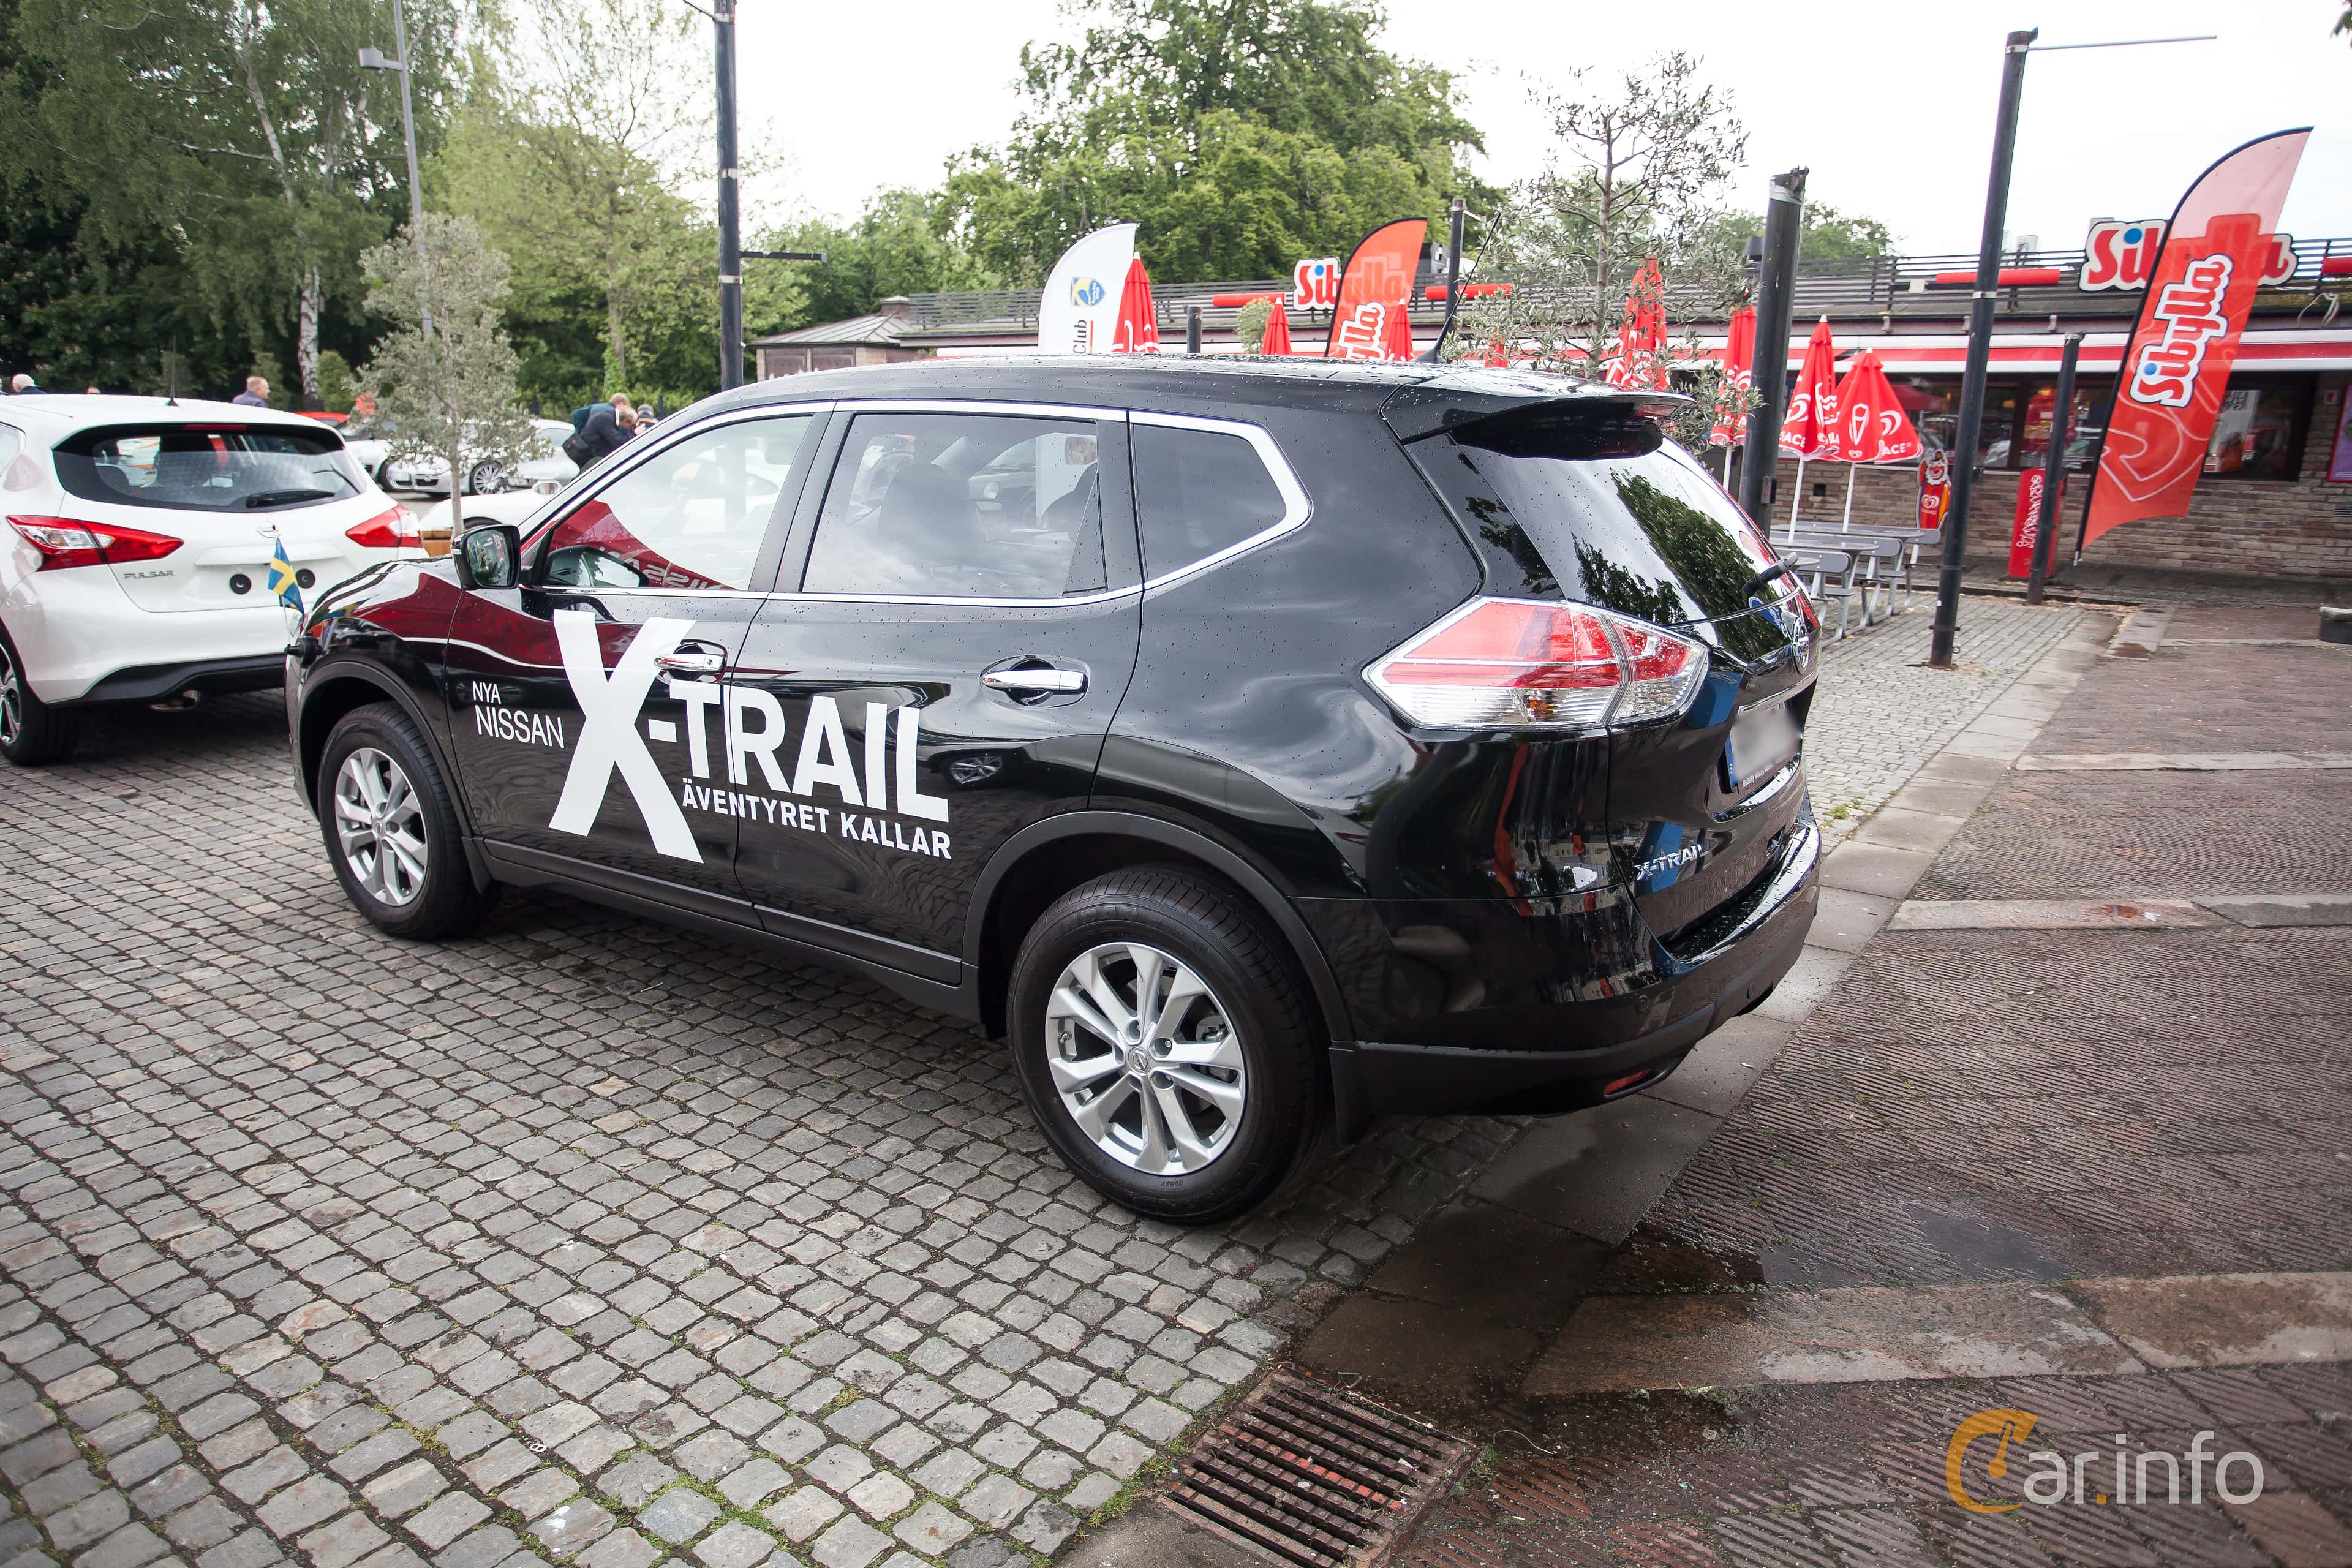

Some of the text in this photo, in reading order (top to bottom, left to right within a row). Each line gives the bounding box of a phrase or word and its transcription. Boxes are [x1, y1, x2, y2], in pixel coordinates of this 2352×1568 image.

[1072, 319, 1087, 353] Club
[2135, 258, 2228, 403] Sibylla
[124, 570, 175, 579] PULSAR
[472, 680, 501, 704] NYA
[475, 704, 565, 749] NISSAN
[548, 609, 949, 864] X-TRAIL
[682, 778, 952, 860] ÄVENTYRET KALLAR
[1634, 844, 1709, 881] X-TRAIL
